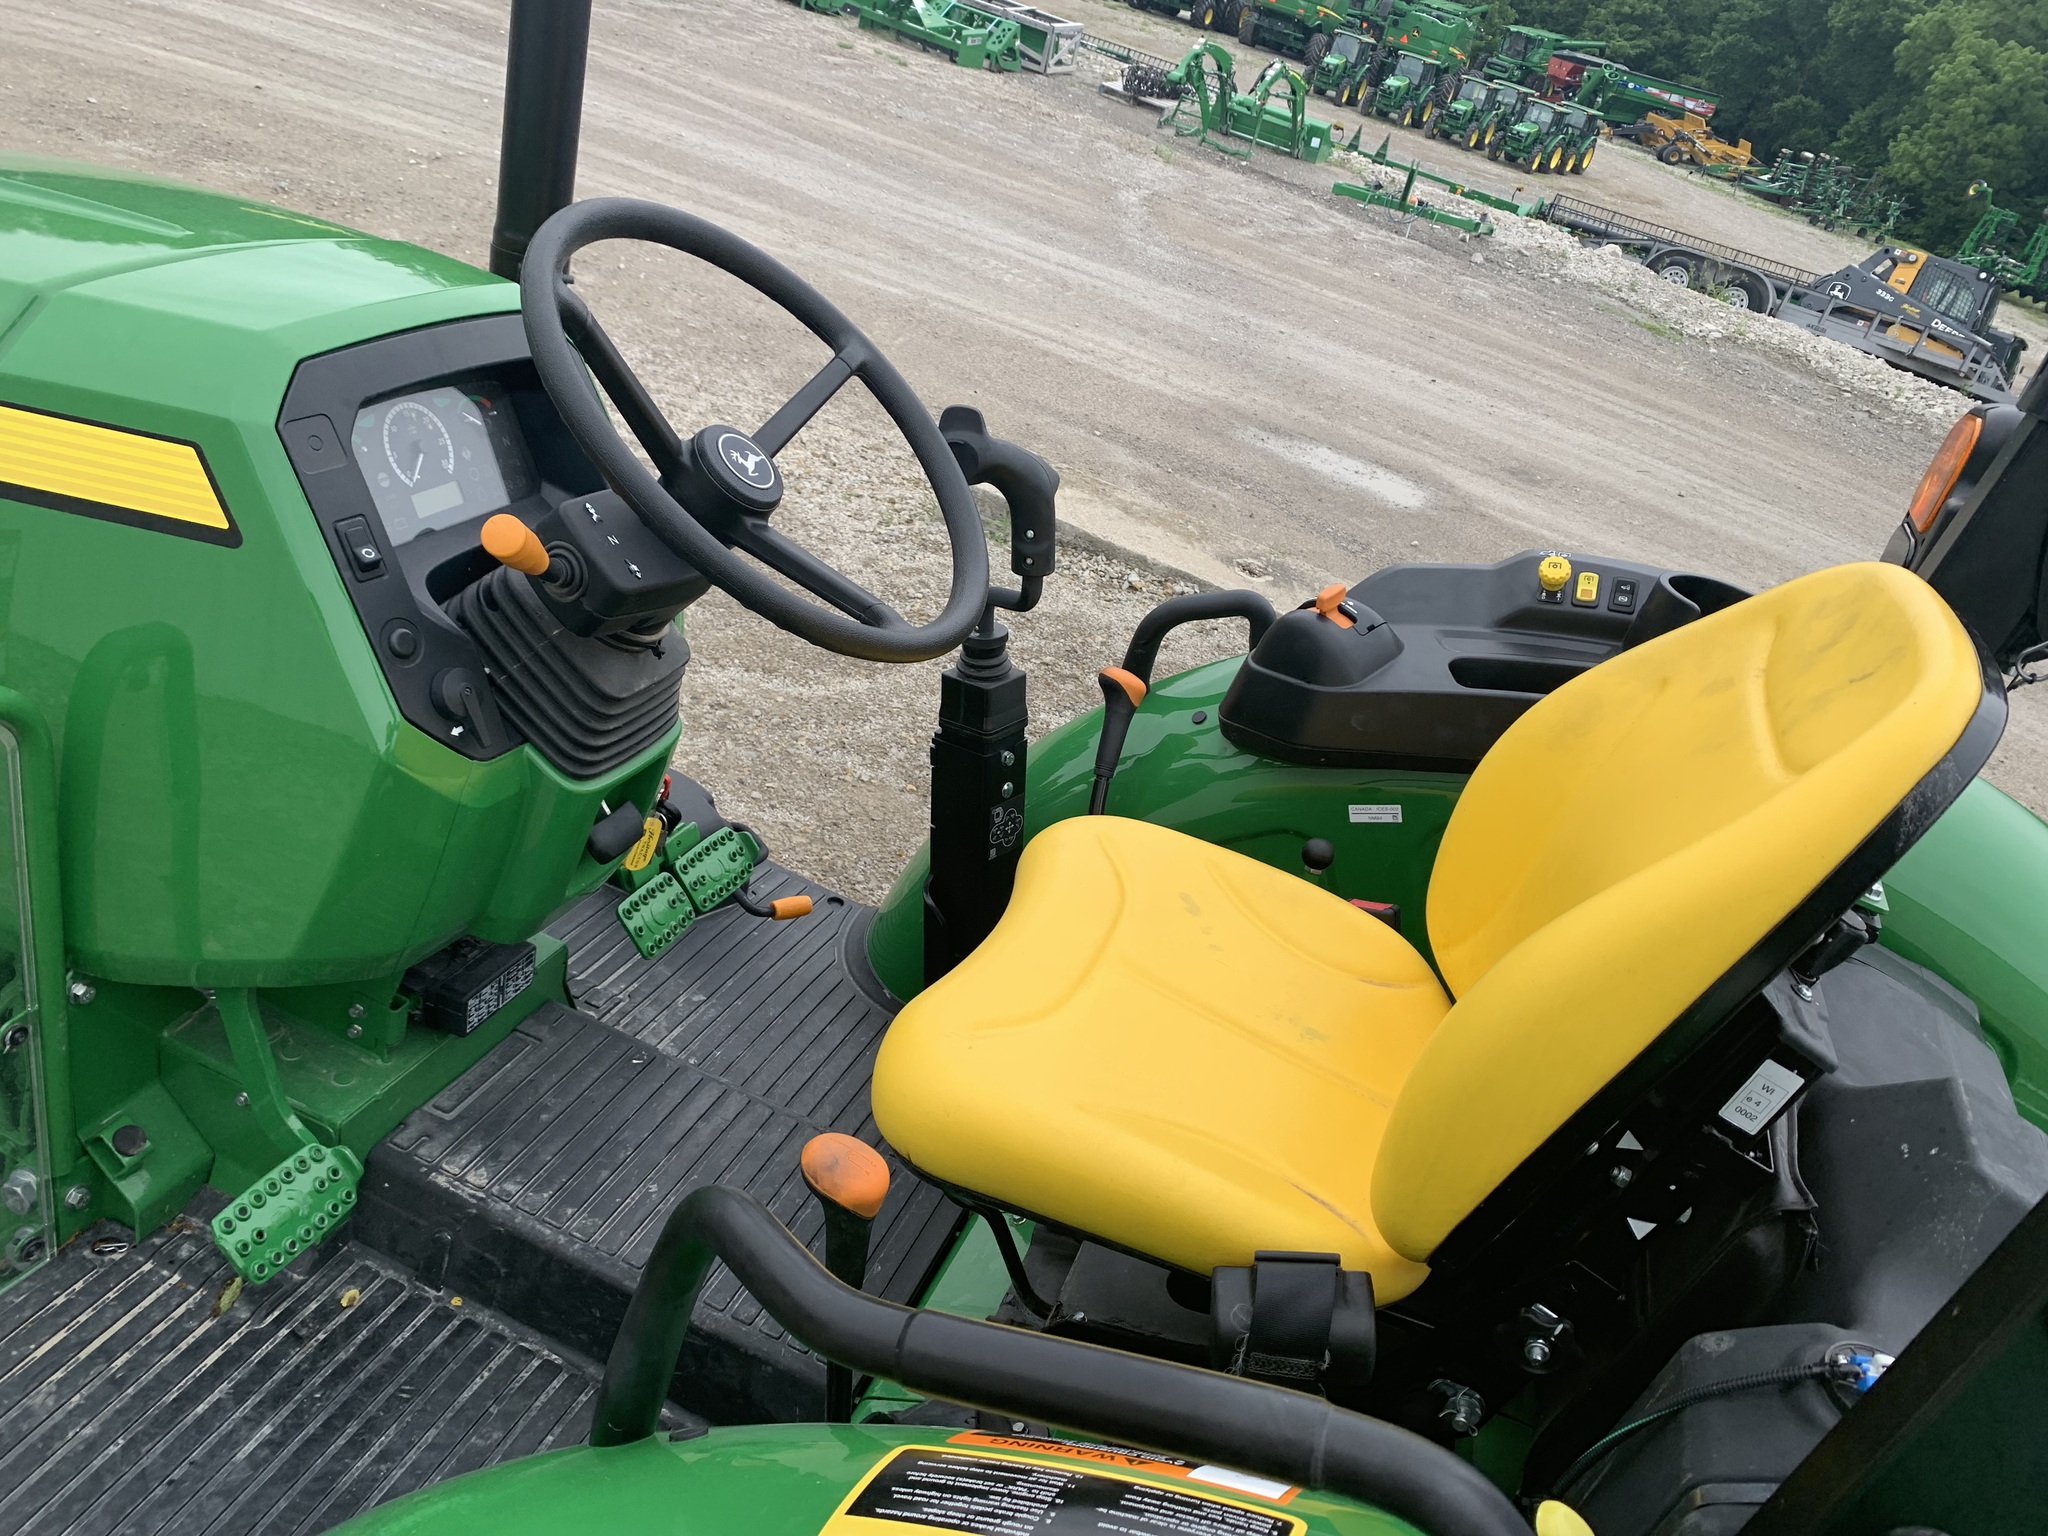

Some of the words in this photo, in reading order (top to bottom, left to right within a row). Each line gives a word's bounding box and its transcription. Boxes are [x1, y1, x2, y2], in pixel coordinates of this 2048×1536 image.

[1876, 288, 1895, 302] 333G
[1734, 1105, 1758, 1122] 0002
[989, 1439, 1116, 1461] WARNING
[954, 1481, 990, 1491] implement
[913, 1489, 942, 1497] highway
[1133, 1486, 1165, 1496] applying
[972, 1497, 1000, 1506] warning
[1036, 1494, 1053, 1502] Stop
[1142, 1497, 1162, 1506] away
[940, 1500, 969, 1508] together
[970, 1504, 994, 1513] pedals
[1001, 1502, 1029, 1512] flashing
[1012, 1499, 1048, 1509] prohibited
[1162, 1502, 1192, 1513] clothing
[1201, 1501, 1222, 1510] when
[946, 1510, 966, 1518] steep
[994, 1508, 1014, 1516] brake
[1109, 1510, 1139, 1520] machine
[1222, 1506, 1245, 1516] speed
[928, 1514, 960, 1525] operating
[976, 1516, 1002, 1524] ground
[1014, 1512, 1040, 1521] Couple
[1175, 1513, 1200, 1522] tractor
[970, 1523, 994, 1531] brakes
[1002, 1520, 1023, 1528] rough
[1190, 1523, 1216, 1533] engine
[1212, 1522, 1235, 1531] riders
[1250, 1524, 1269, 1534] Keep
